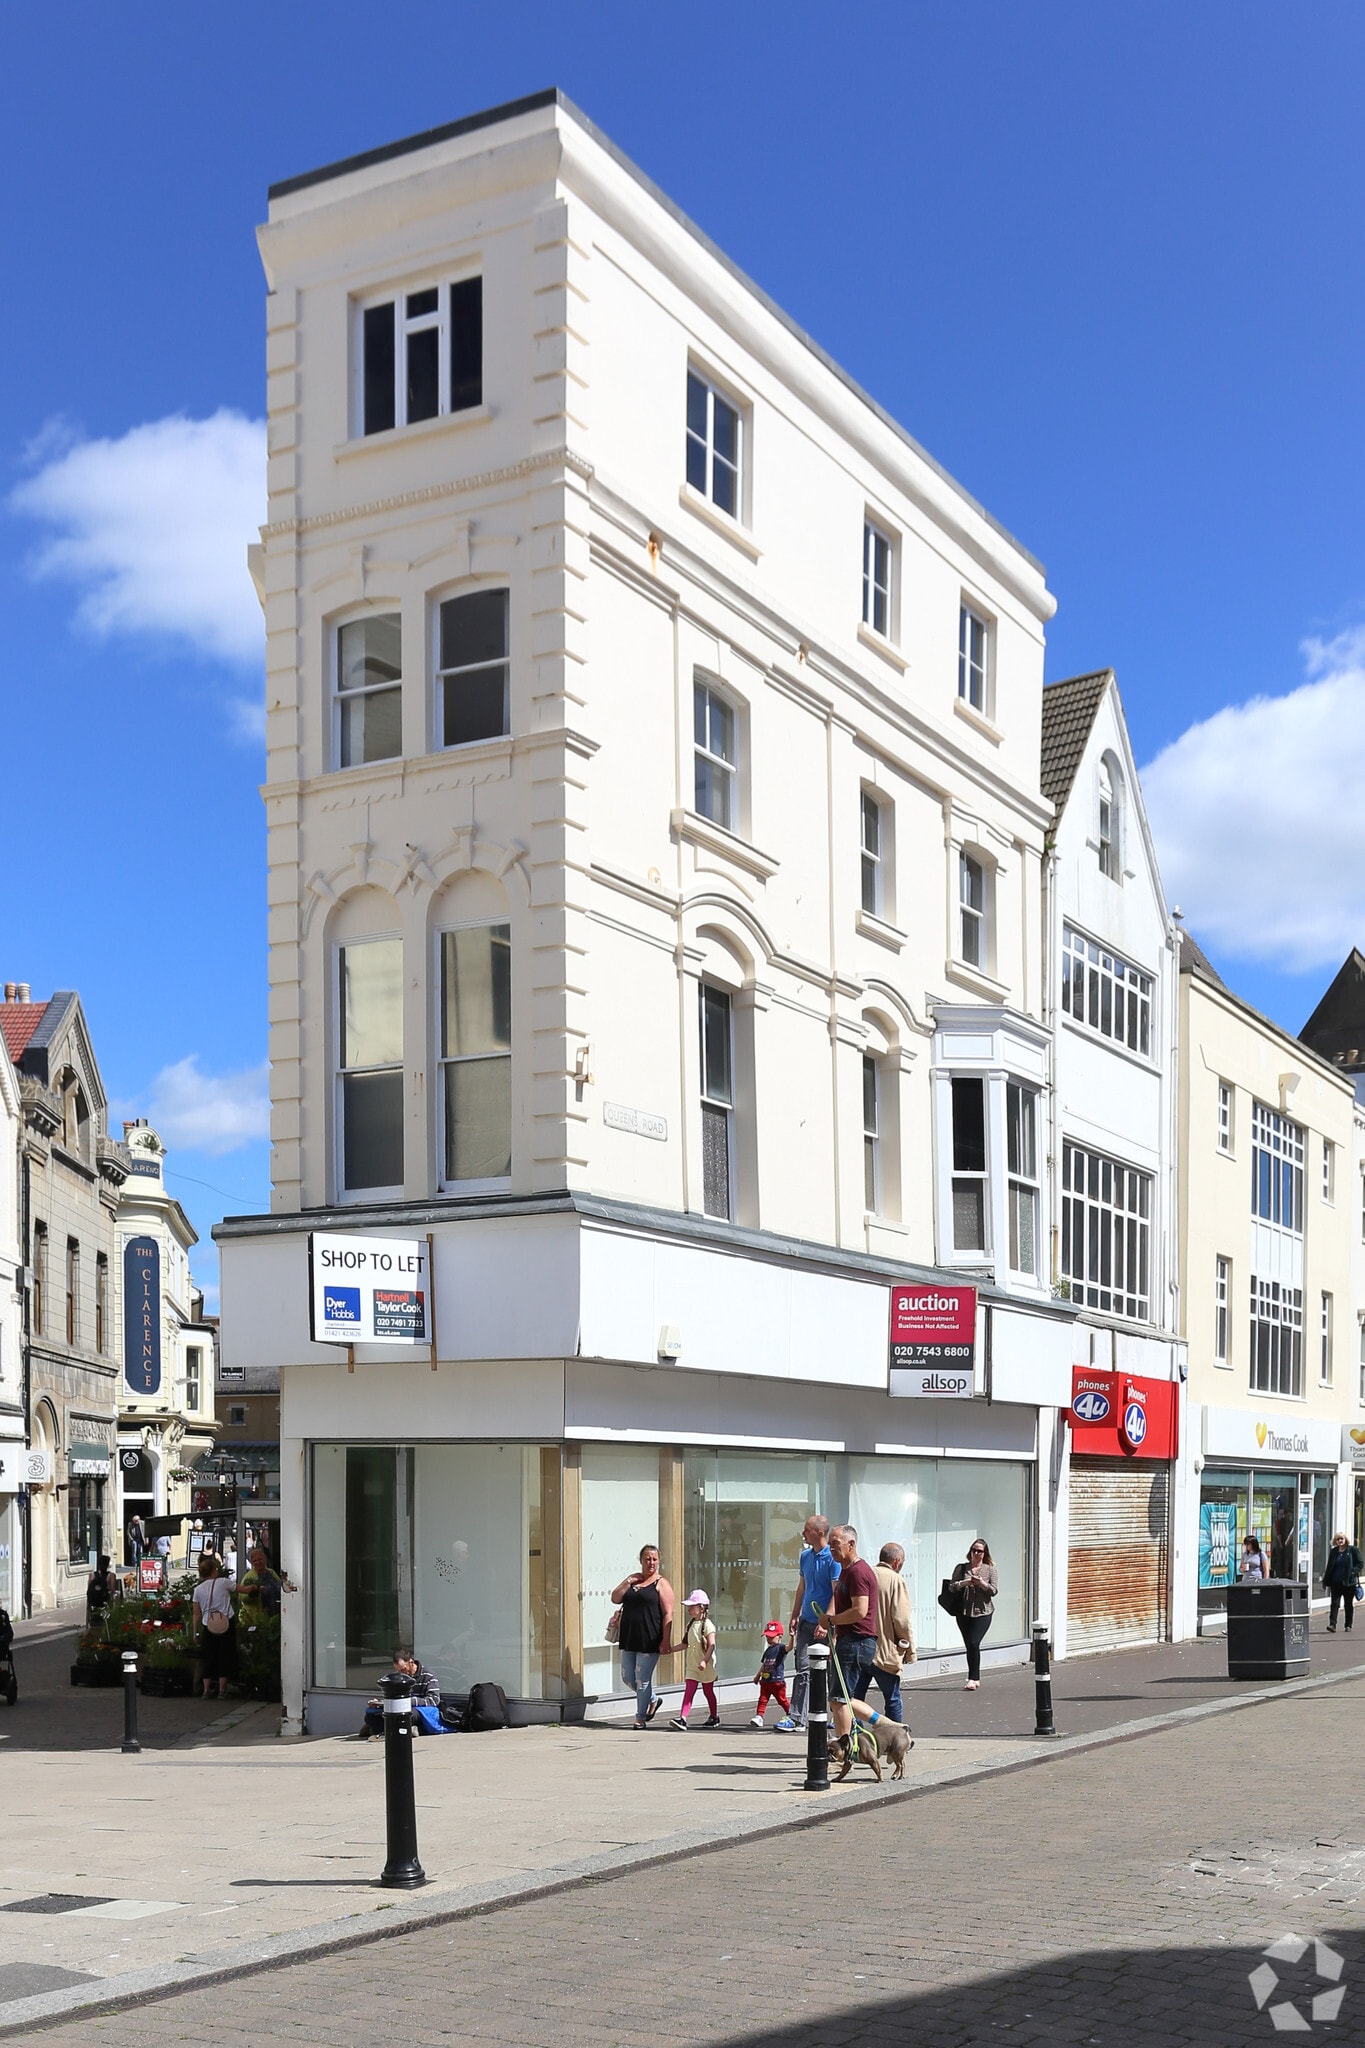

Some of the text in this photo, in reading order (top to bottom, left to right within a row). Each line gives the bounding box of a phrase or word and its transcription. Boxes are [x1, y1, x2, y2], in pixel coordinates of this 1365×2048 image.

[608, 1108, 664, 1133] QUEENS ROAD
[136, 1248, 153, 1256] THE
[322, 1250, 424, 1273] SHOP TO LET
[326, 1297, 346, 1308] Dyer
[376, 1291, 410, 1302] Hartnell
[898, 1294, 958, 1311] auction
[142, 1269, 152, 1386] CLARENCE
[376, 1318, 390, 1326] 020
[391, 1318, 406, 1326] 7491
[894, 1346, 970, 1356] 020 7543 6800
[922, 1374, 966, 1393] allsop
[1078, 1380, 1110, 1391] phones
[1128, 1386, 1146, 1404] phones
[1077, 1394, 1106, 1418] 4u
[1127, 1406, 1144, 1440] 4u
[1268, 1430, 1308, 1453] Thomas Cook
[1210, 1522, 1229, 1546] WIN
[1210, 1547, 1228, 1566] £1000
[142, 1570, 160, 1578] SALE
